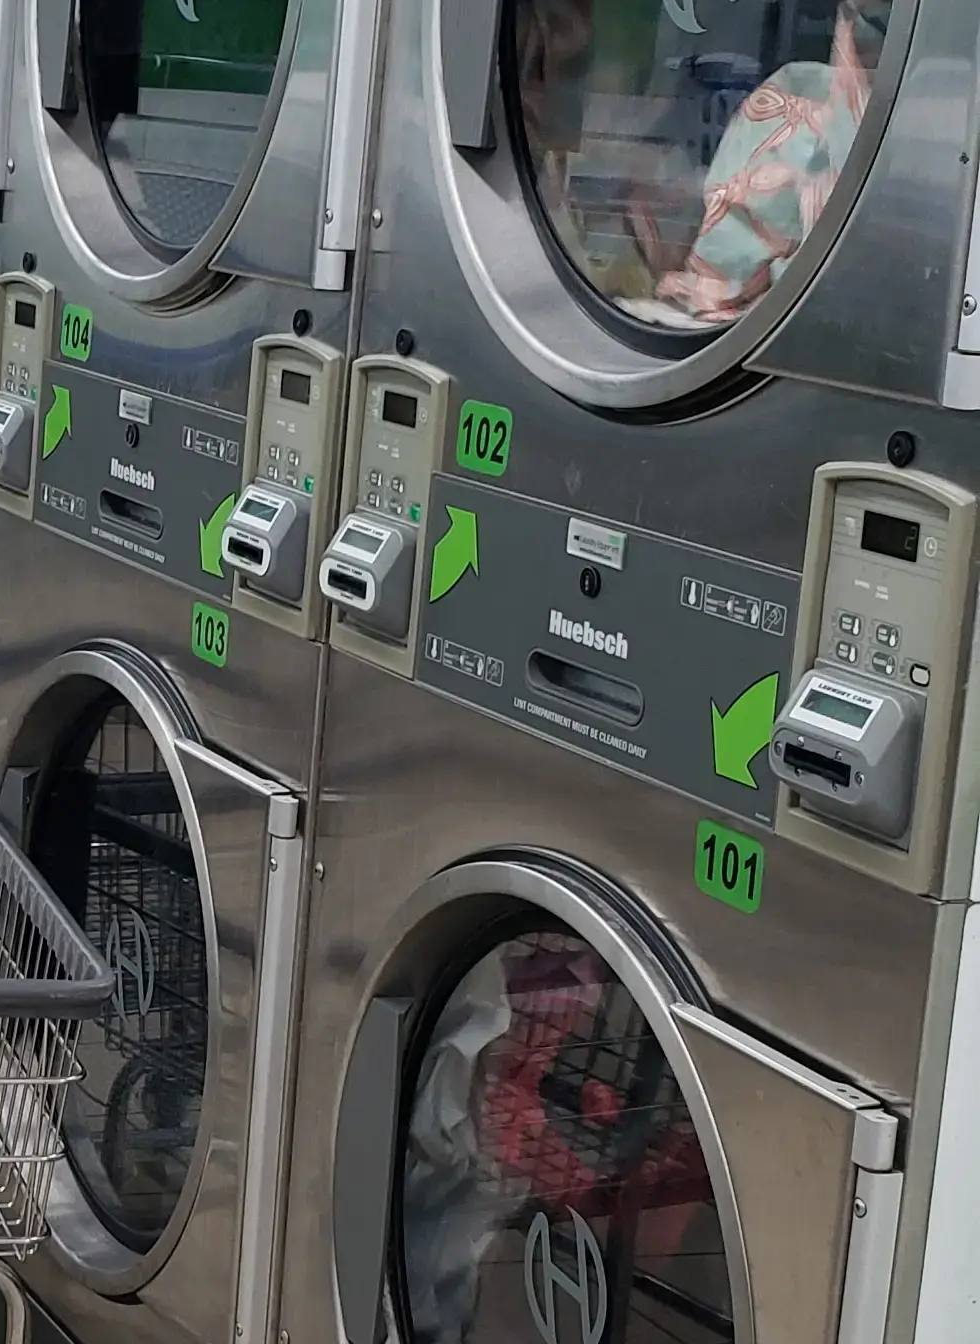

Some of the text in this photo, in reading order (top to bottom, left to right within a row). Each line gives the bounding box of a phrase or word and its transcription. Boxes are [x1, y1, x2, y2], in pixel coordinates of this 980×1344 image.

[64, 313, 90, 352] 104
[462, 412, 507, 464] 102
[110, 457, 155, 491] Huebsch
[195, 611, 226, 657] 103
[548, 608, 629, 660] Huebsch
[513, 697, 648, 759] LINT COMPARTMENT MUST BE CLEANED DAILY
[703, 834, 758, 901] 101
